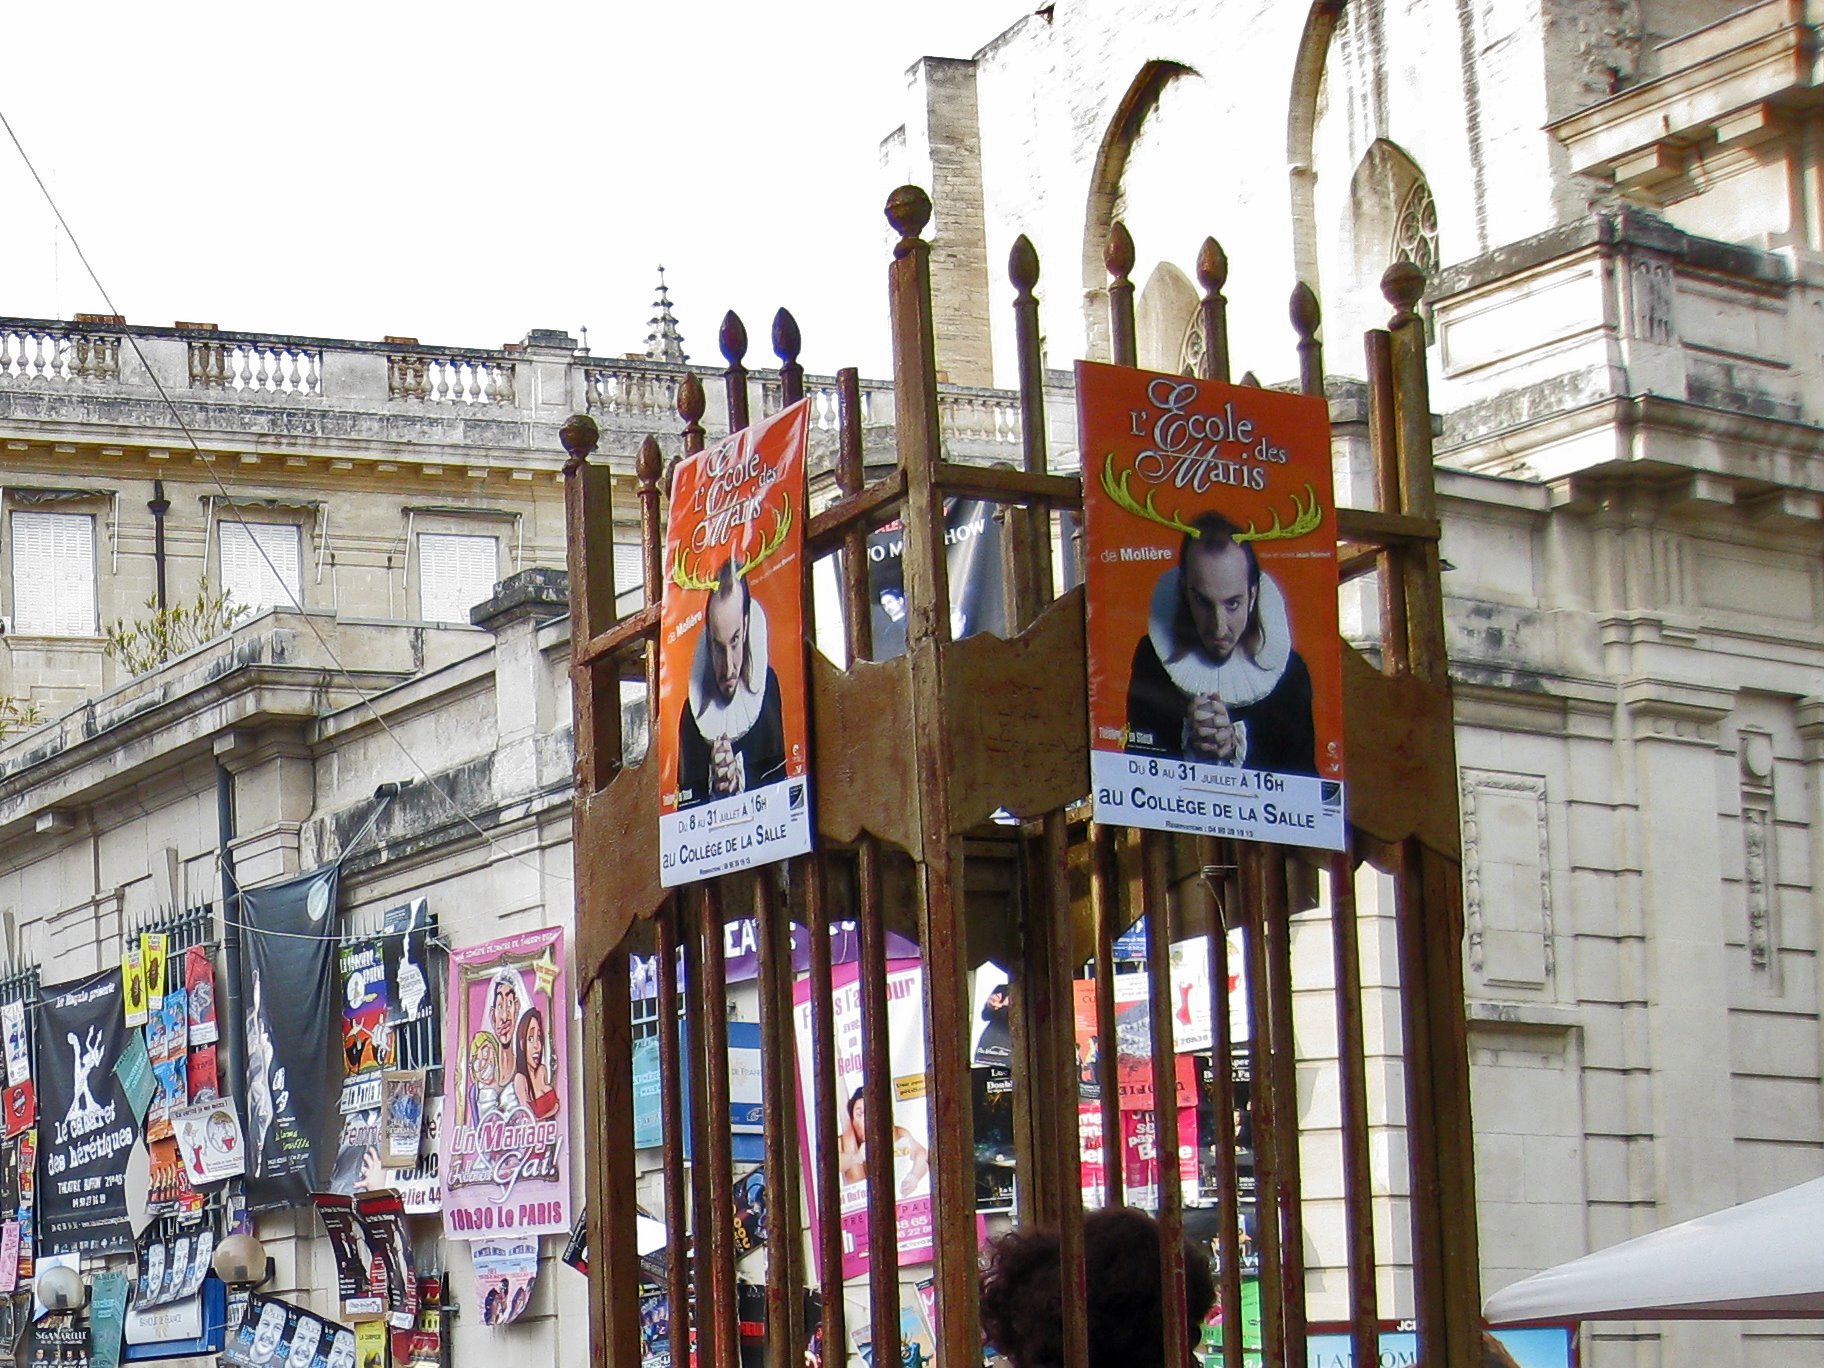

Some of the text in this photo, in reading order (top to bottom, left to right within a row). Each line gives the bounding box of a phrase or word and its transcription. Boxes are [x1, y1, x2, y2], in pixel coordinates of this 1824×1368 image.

[1255, 437, 1287, 464] des
[759, 467, 777, 489] des
[1135, 442, 1264, 493] Maris
[692, 490, 761, 553] Maris
[944, 518, 986, 546] HOW
[1101, 547, 1172, 563] de Molière
[676, 611, 702, 635] Molière
[1149, 759, 1158, 776] 8
[1178, 763, 1197, 781] 31
[1099, 788, 1123, 806] au
[689, 815, 696, 830] 8
[707, 809, 717, 826] 31
[663, 853, 675, 869] au
[845, 977, 915, 1012] l'aour
[838, 1056, 863, 1076] Belg
[55, 1100, 115, 1145] le cabaret
[451, 1120, 557, 1154] Un Mariage
[48, 1126, 132, 1176] des hérétiques
[498, 1206, 514, 1228] Le
[519, 1201, 562, 1226] PARIS
